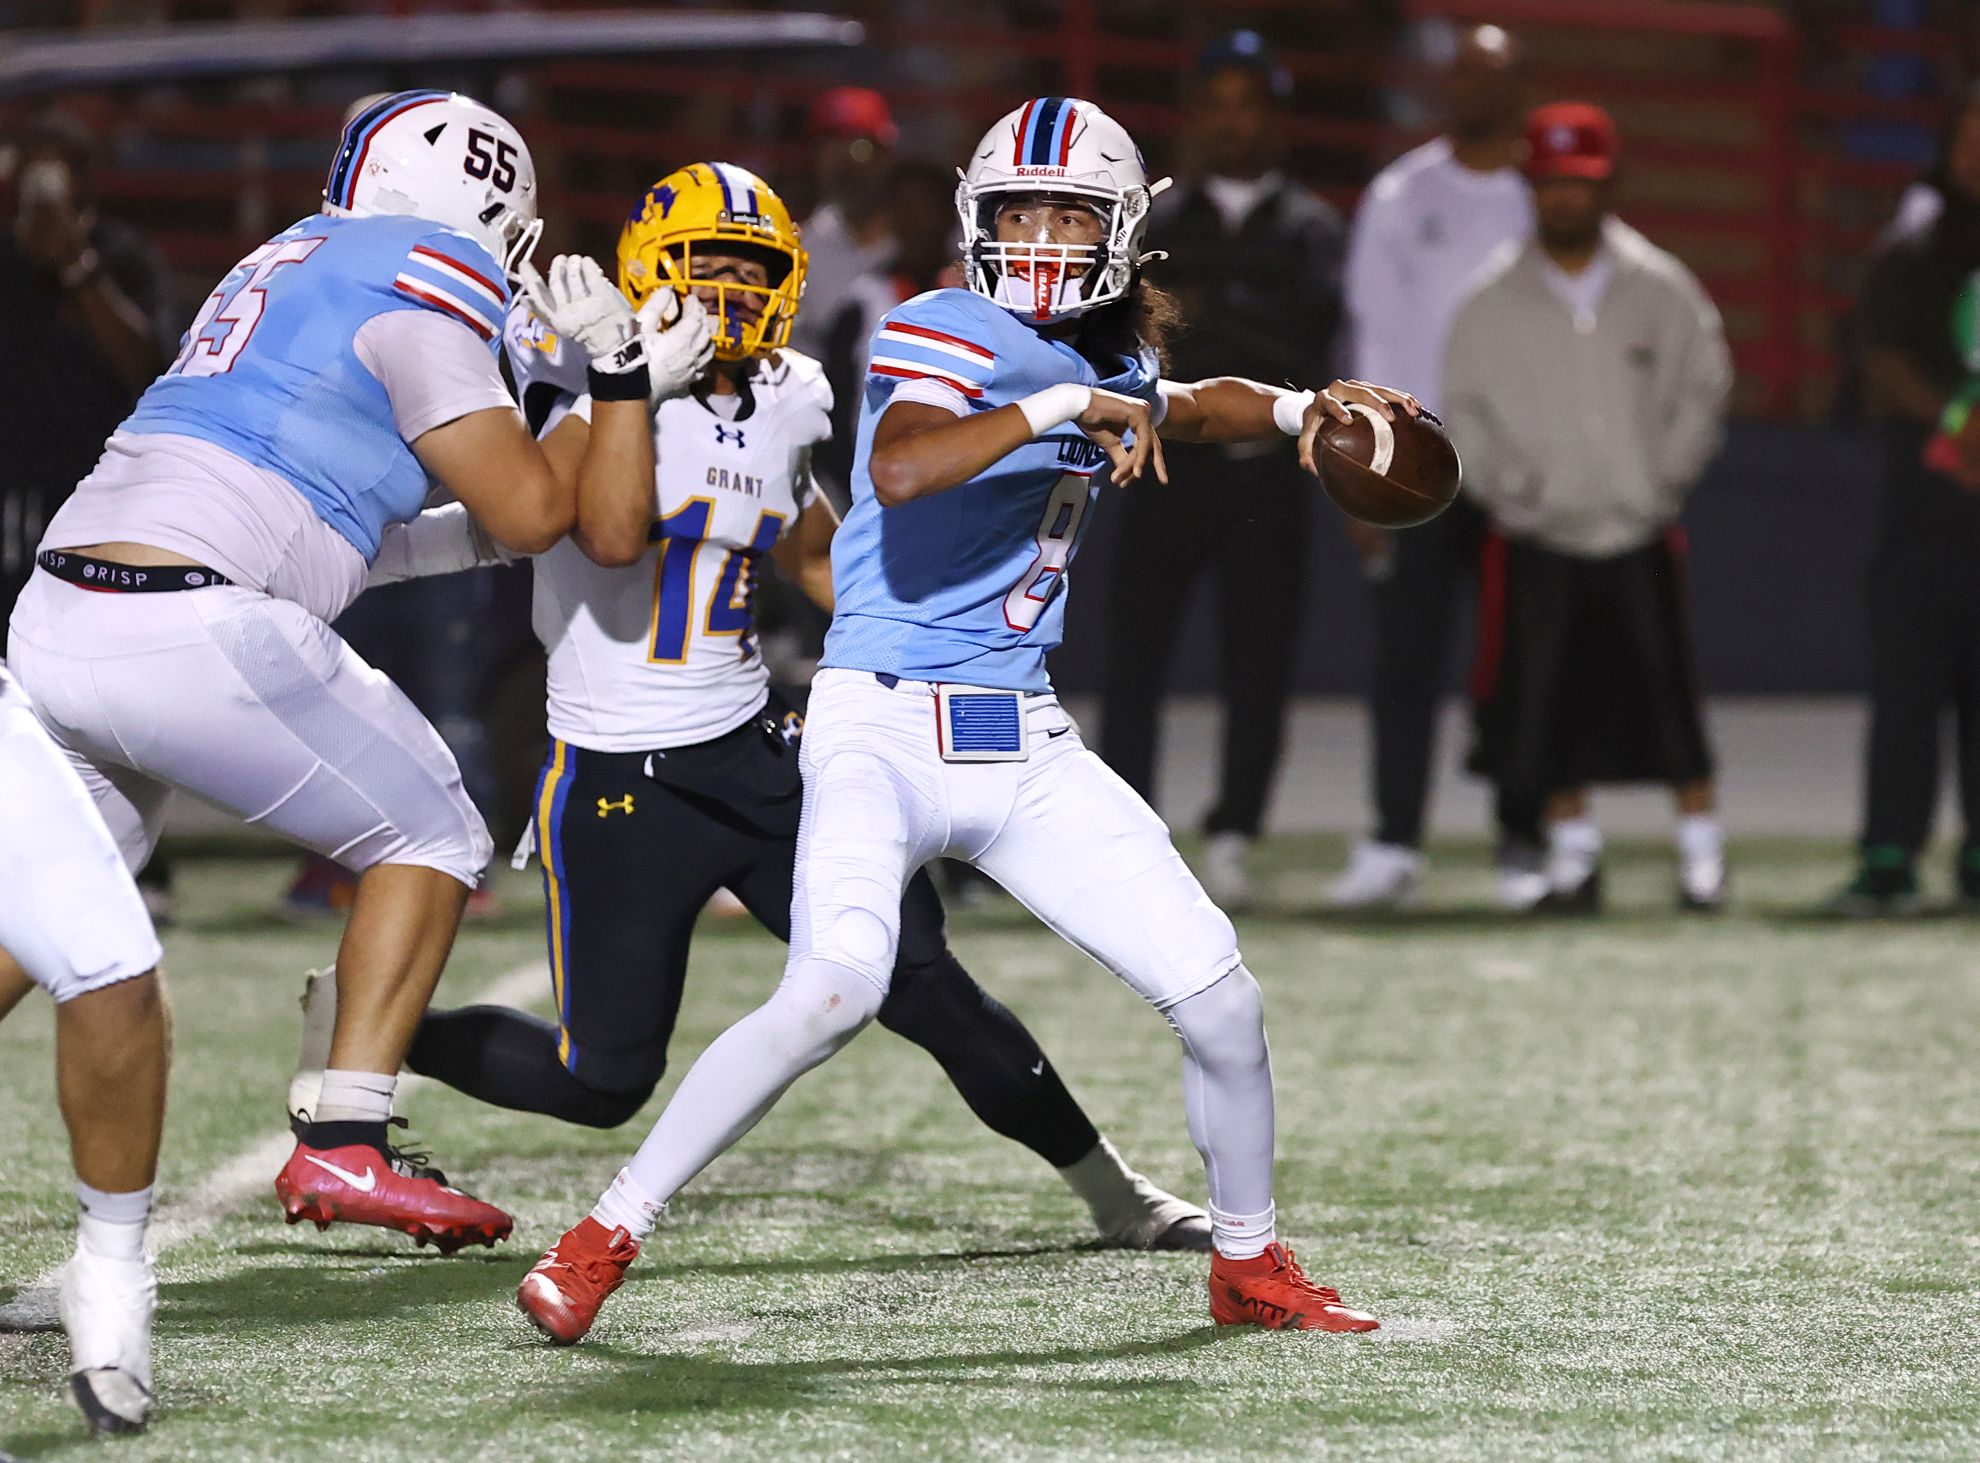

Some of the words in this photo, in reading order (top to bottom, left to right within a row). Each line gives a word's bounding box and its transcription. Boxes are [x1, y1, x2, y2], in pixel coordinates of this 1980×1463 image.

[464, 127, 518, 194] 55
[1016, 167, 1065, 177] Riddell
[706, 466, 763, 499] GRANT
[648, 495, 787, 664] 14
[1003, 472, 1092, 632] 8
